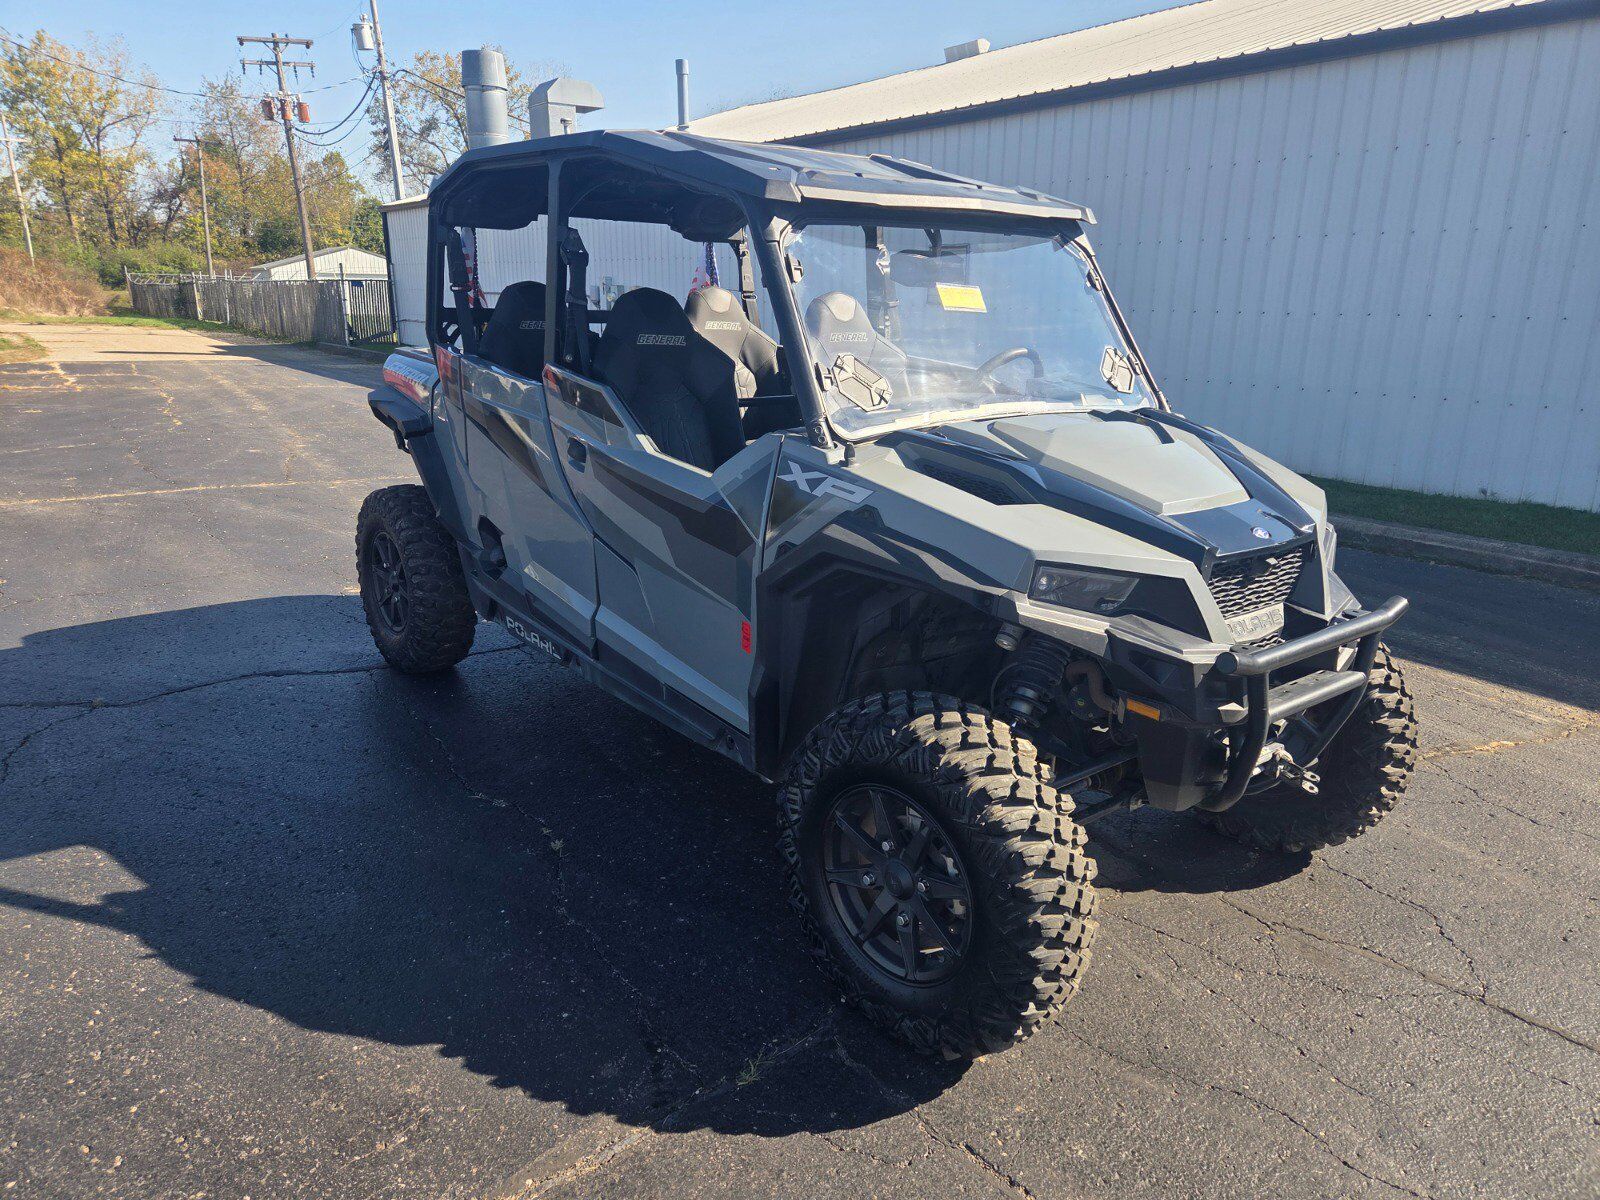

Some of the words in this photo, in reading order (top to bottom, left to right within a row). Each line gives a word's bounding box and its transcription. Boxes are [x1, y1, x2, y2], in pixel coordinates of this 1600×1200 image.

[520, 320, 546, 330] GENE
[705, 320, 742, 331] GENERAL
[637, 333, 687, 347] GENERAL
[830, 332, 868, 343] GENERAL
[777, 460, 874, 504] XP
